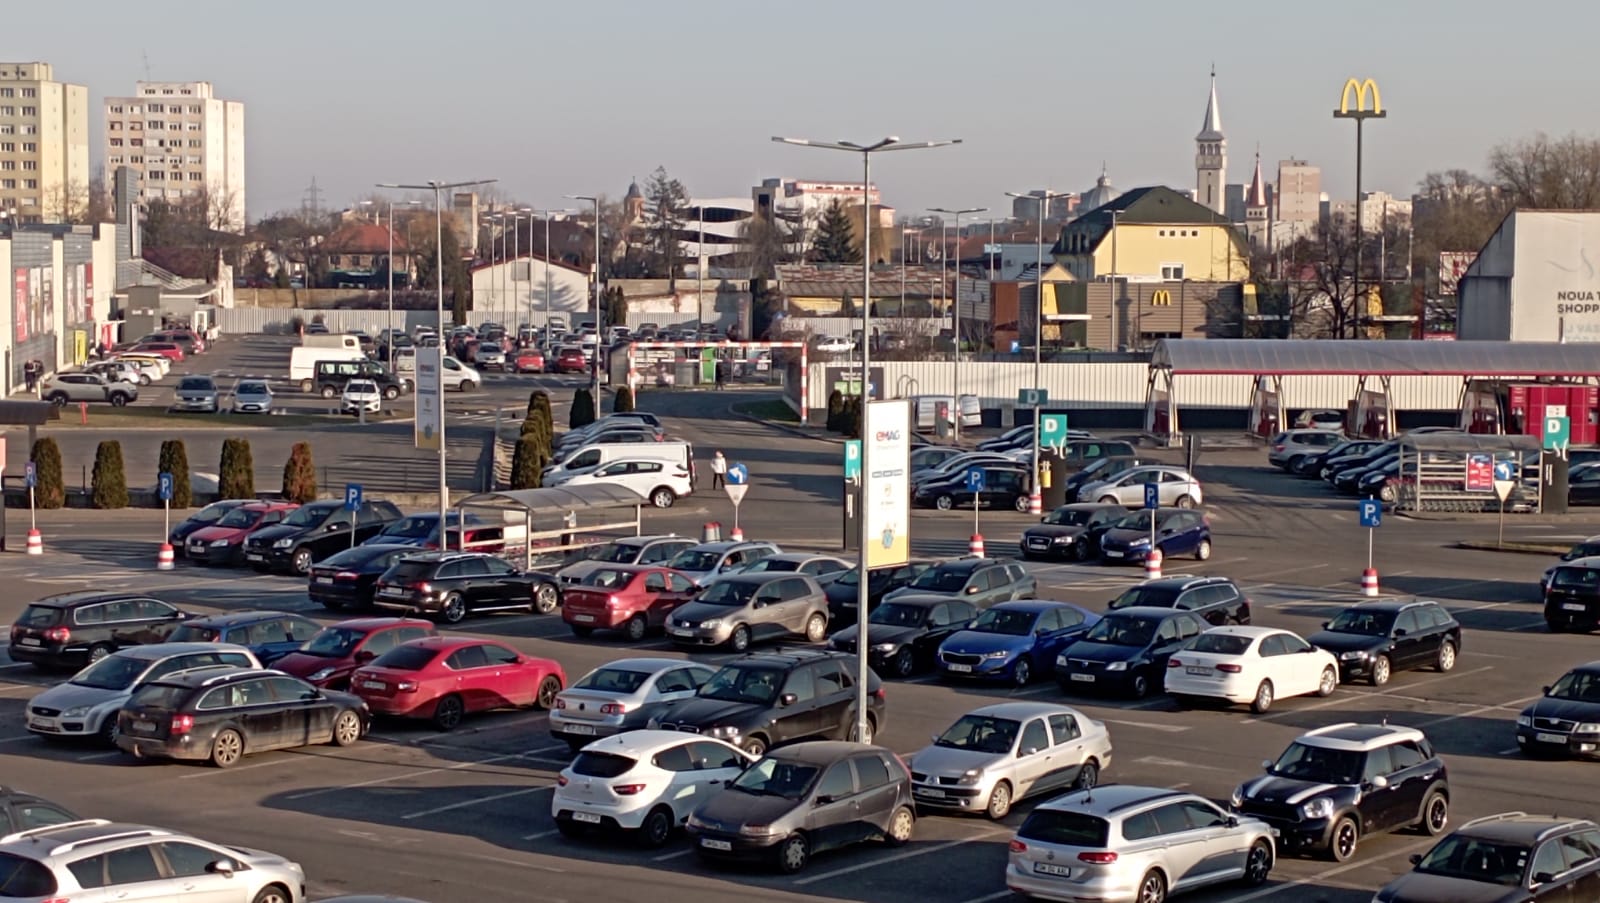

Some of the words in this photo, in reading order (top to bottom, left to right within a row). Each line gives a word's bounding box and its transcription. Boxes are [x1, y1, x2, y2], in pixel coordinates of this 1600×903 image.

[1557, 291, 1594, 301] NOUA
[1026, 391, 1039, 404] D
[1044, 418, 1058, 433] D
[1547, 419, 1560, 433] D
[848, 444, 858, 460] D
[162, 478, 169, 493] P
[971, 471, 981, 485] P
[349, 488, 358, 504] P
[1147, 487, 1155, 502] P
[1365, 504, 1376, 519] P
